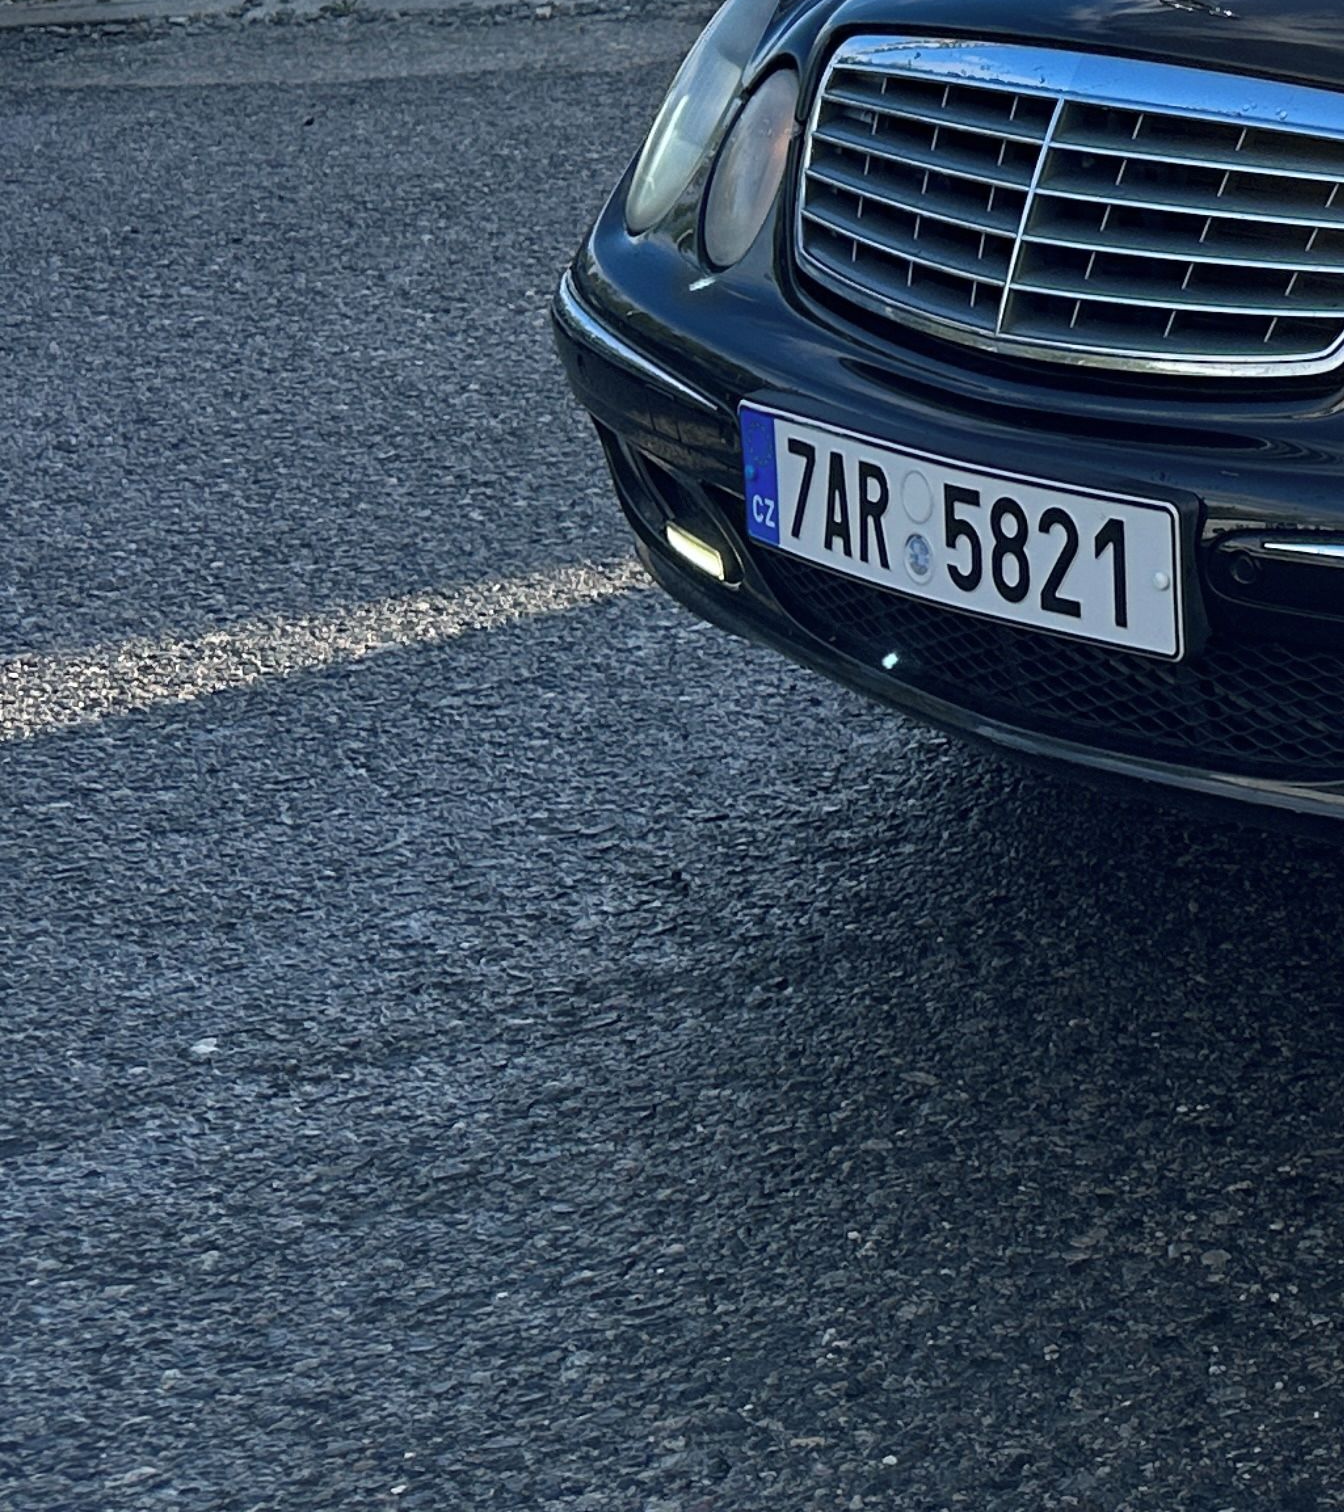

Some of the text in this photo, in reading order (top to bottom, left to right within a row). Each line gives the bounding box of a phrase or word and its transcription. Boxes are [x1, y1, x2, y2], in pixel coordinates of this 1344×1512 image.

[751, 437, 1128, 629] CZ 7AR 5821
